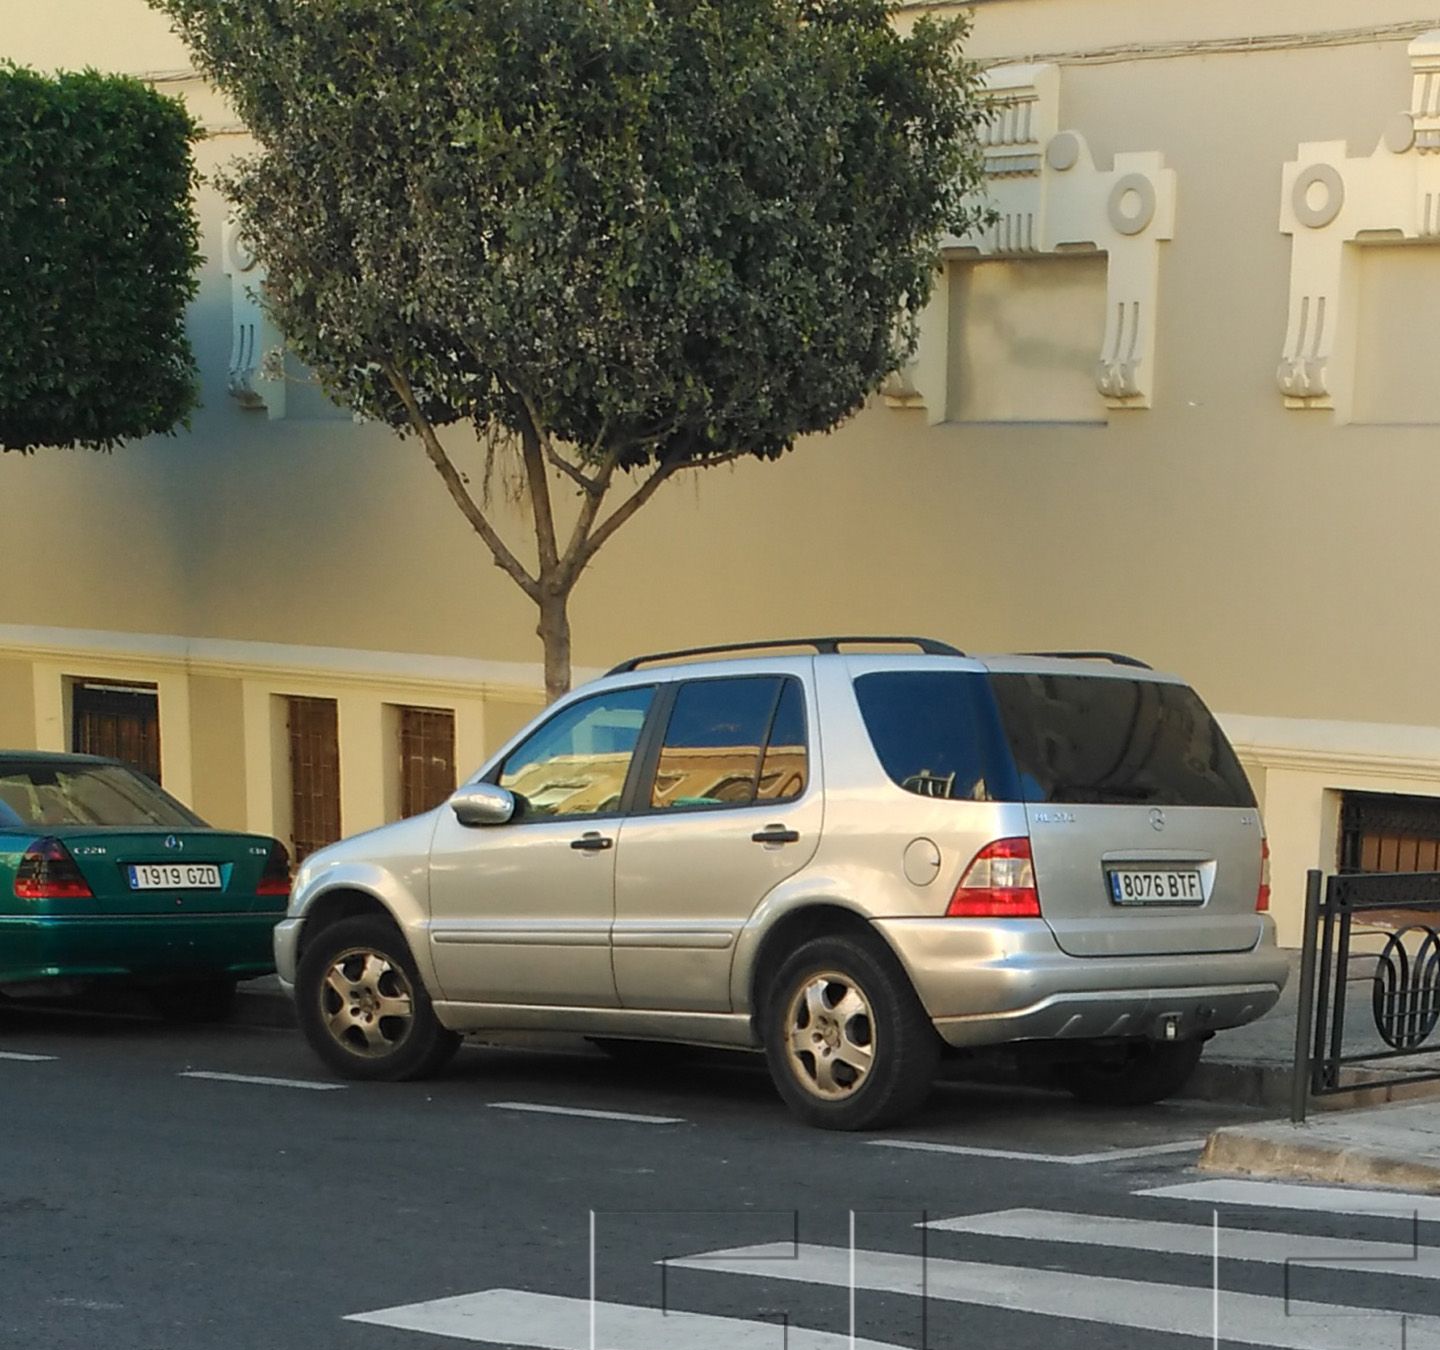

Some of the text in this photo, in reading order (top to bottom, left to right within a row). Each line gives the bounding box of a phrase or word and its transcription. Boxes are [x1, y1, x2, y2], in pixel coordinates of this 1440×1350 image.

[142, 868, 217, 885] 1919 GZD
[1123, 874, 1196, 897] 8076 BTF
